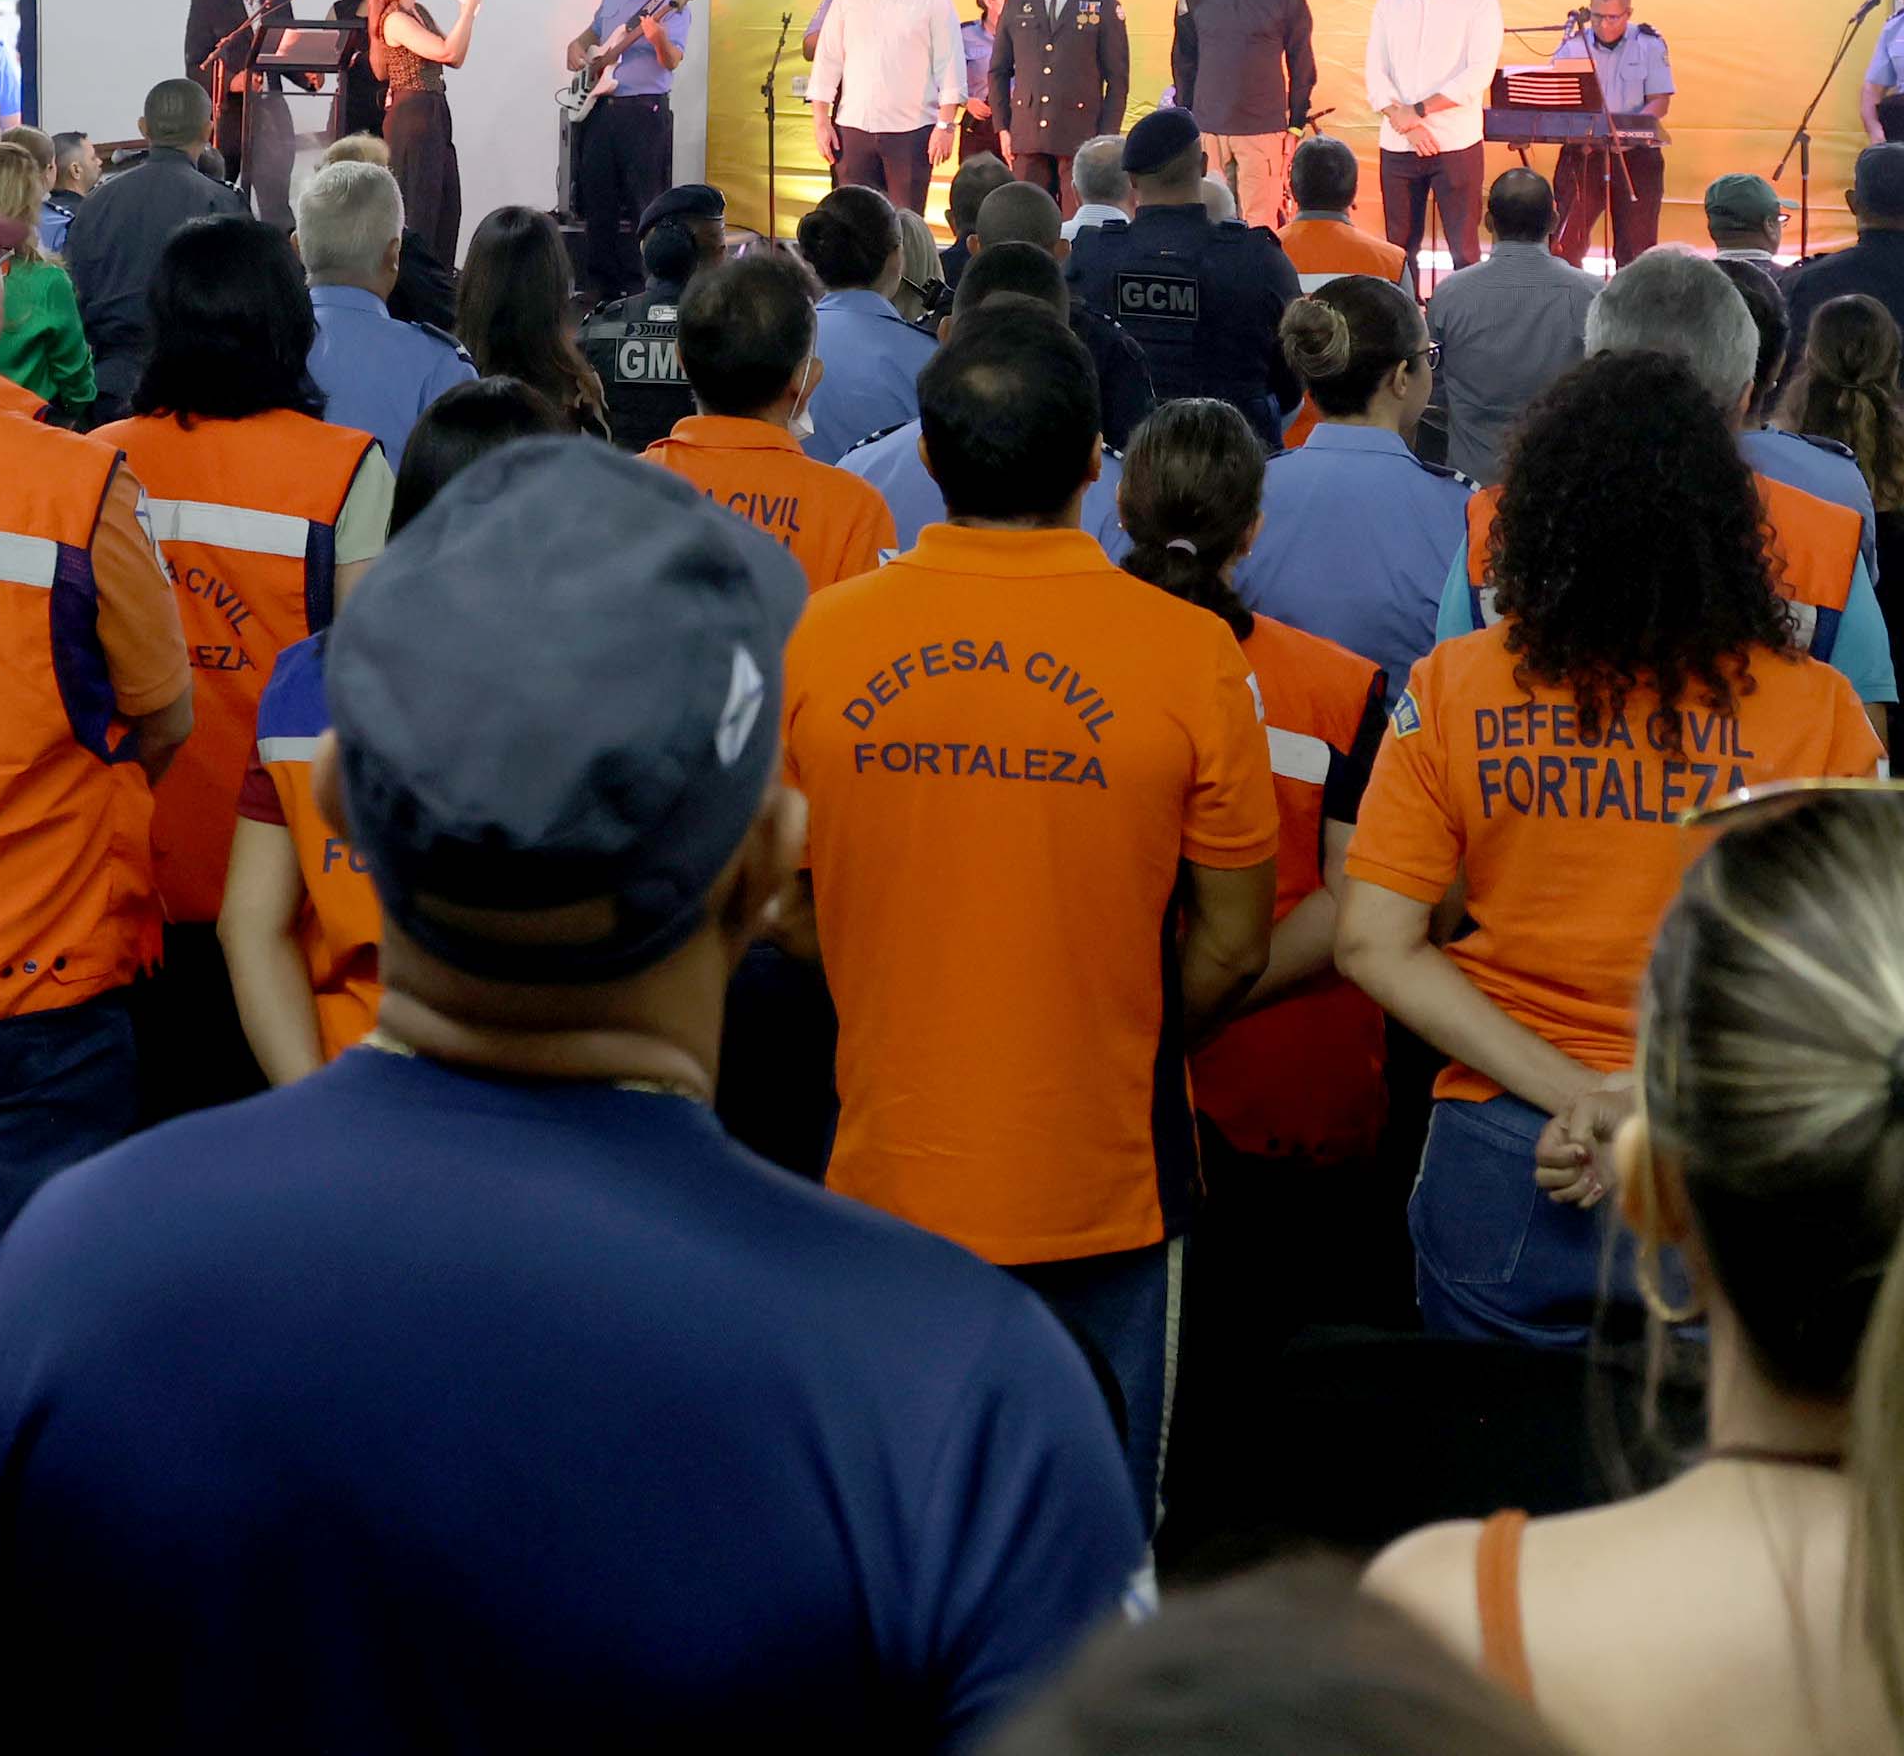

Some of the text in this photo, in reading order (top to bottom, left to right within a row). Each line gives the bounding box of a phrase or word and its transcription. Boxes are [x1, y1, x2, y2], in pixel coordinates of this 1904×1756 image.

[1122, 281, 1195, 313] GCM
[619, 340, 688, 380] GM
[186, 567, 253, 636] CIVIL
[842, 640, 1114, 743] DEFESA CIVIL
[1646, 708, 1754, 759] CVIL
[854, 742, 1108, 790] FORTALEZA
